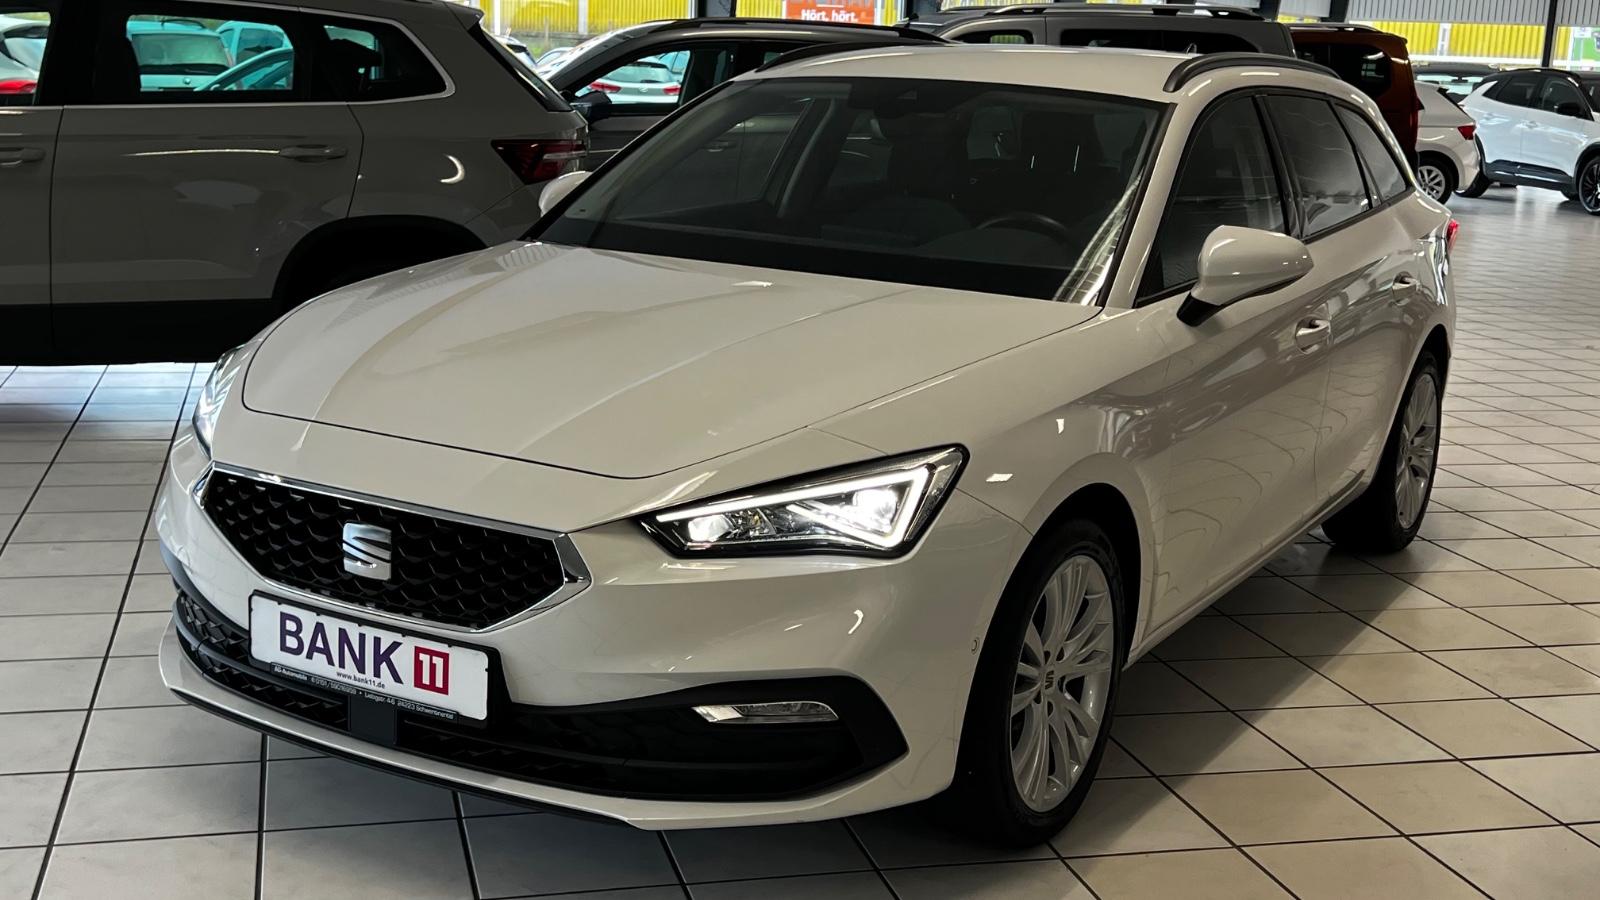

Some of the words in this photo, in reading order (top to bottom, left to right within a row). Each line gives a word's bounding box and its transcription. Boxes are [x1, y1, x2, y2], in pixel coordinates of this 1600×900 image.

[279, 611, 404, 685] BANK
[417, 652, 446, 690] 11
[336, 671, 386, 689] www.bank11.de
